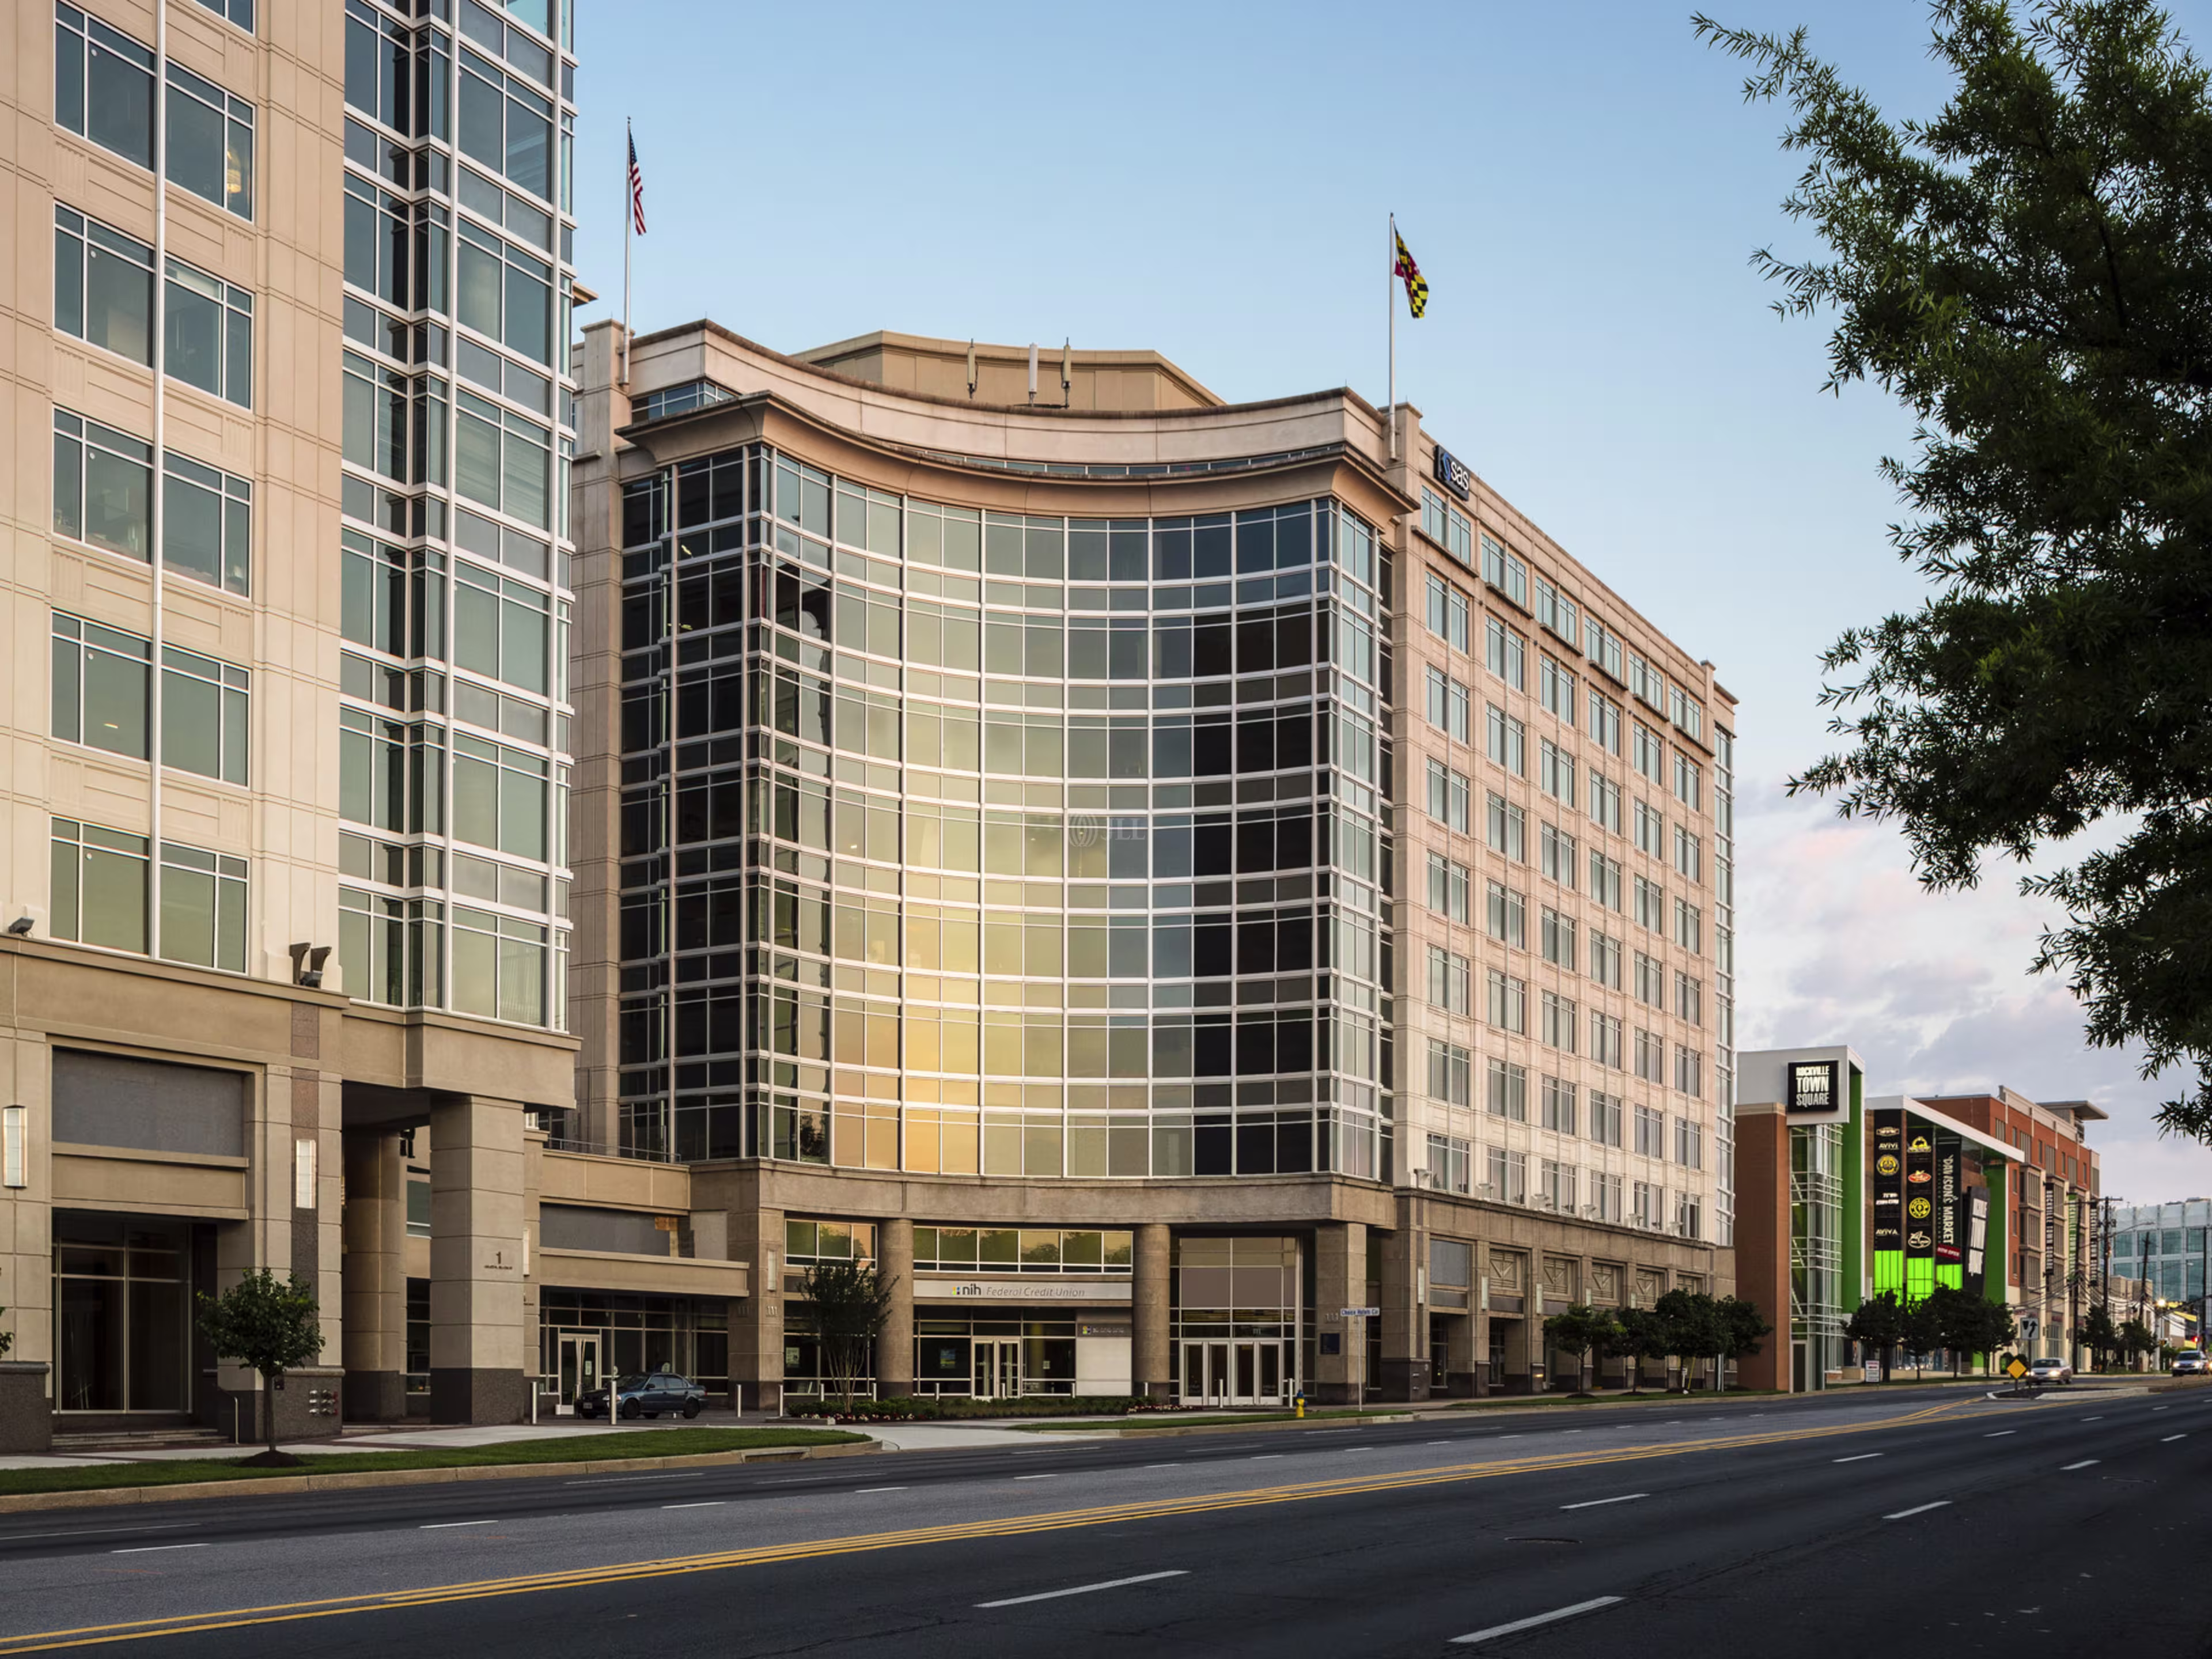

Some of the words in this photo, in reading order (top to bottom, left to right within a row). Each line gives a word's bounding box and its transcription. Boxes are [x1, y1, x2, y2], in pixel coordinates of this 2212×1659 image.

[1450, 461, 1469, 491] sas
[1796, 1066, 1830, 1076] ROCKVILLE
[1796, 1075, 1830, 1093] TOWN
[1796, 1093, 1830, 1107] SQUARE
[1943, 1206, 1954, 1244] MARKET
[496, 1251, 502, 1264] 1
[962, 1283, 982, 1296] nih
[986, 1287, 1022, 1296] Federal
[1024, 1287, 1053, 1297] Credit
[1055, 1287, 1085, 1297] Union
